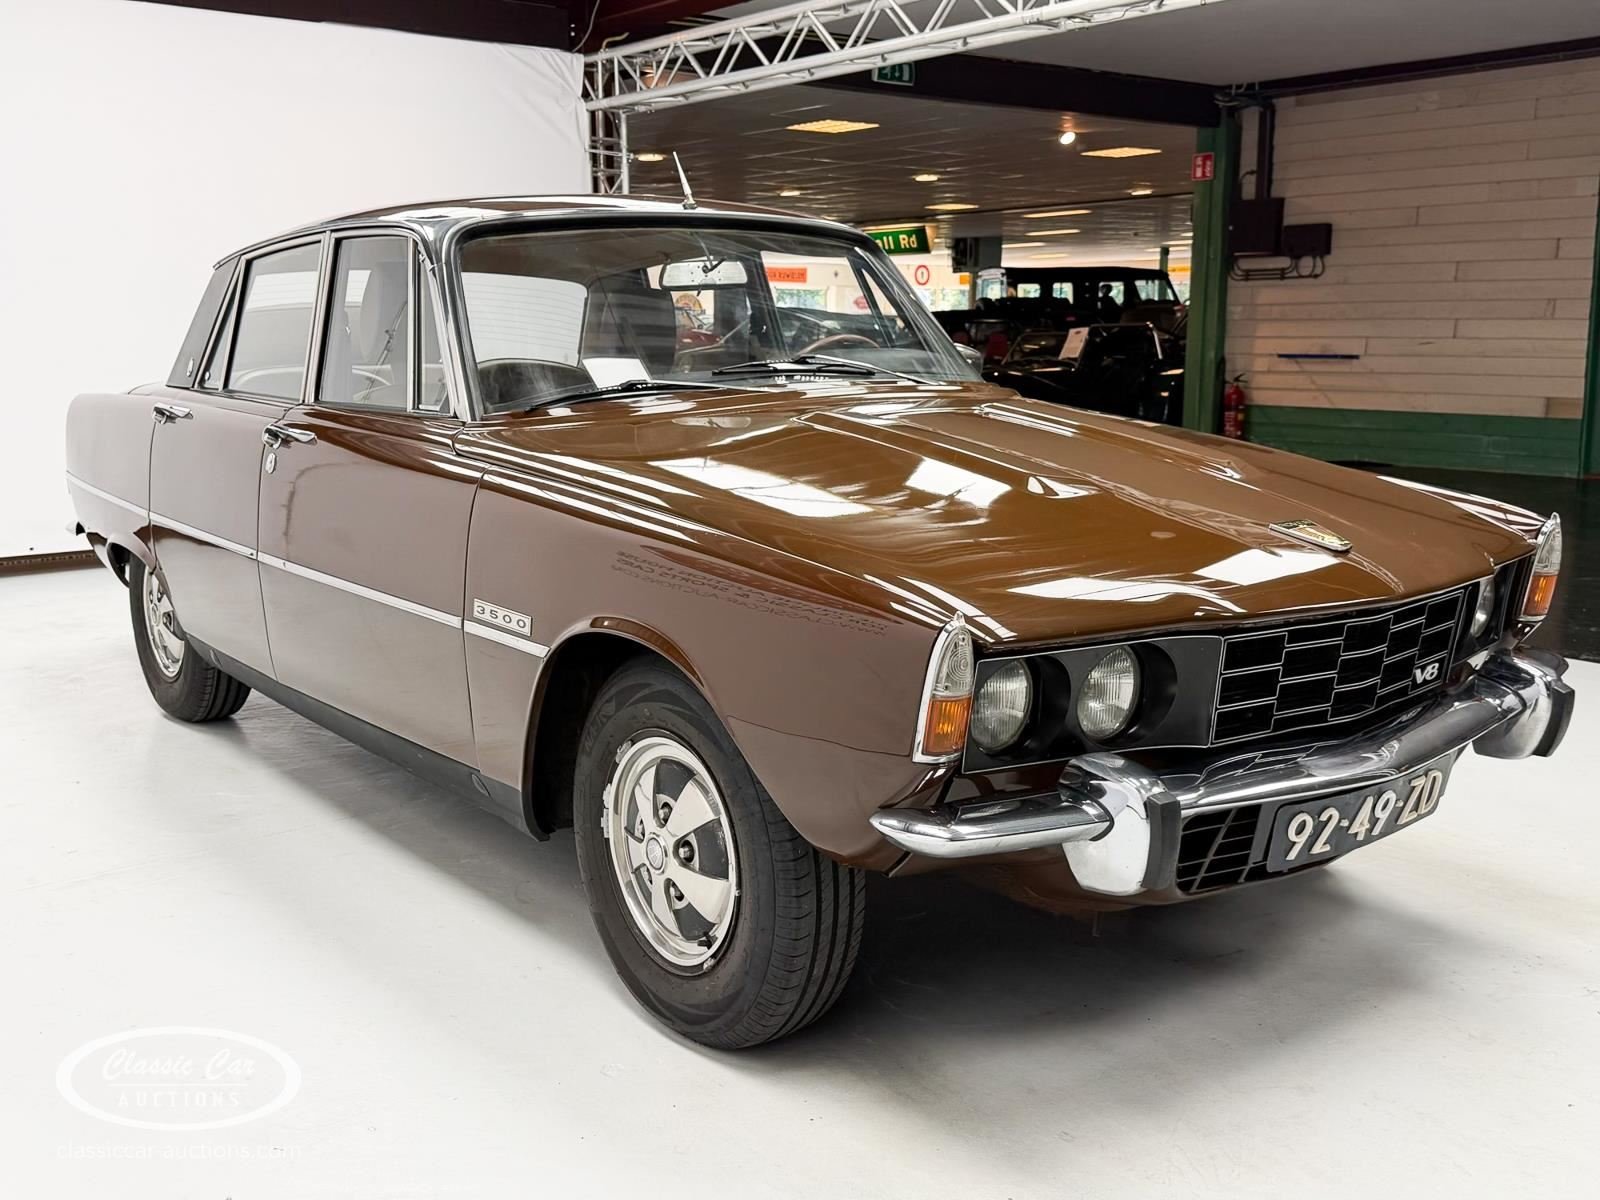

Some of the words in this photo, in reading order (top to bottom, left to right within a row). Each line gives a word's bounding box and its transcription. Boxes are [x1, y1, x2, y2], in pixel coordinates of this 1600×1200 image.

[898, 233, 918, 249] Rd
[476, 605, 527, 629] 3500
[1414, 662, 1440, 684] V8
[1285, 769, 1443, 861] 92-49-ZD
